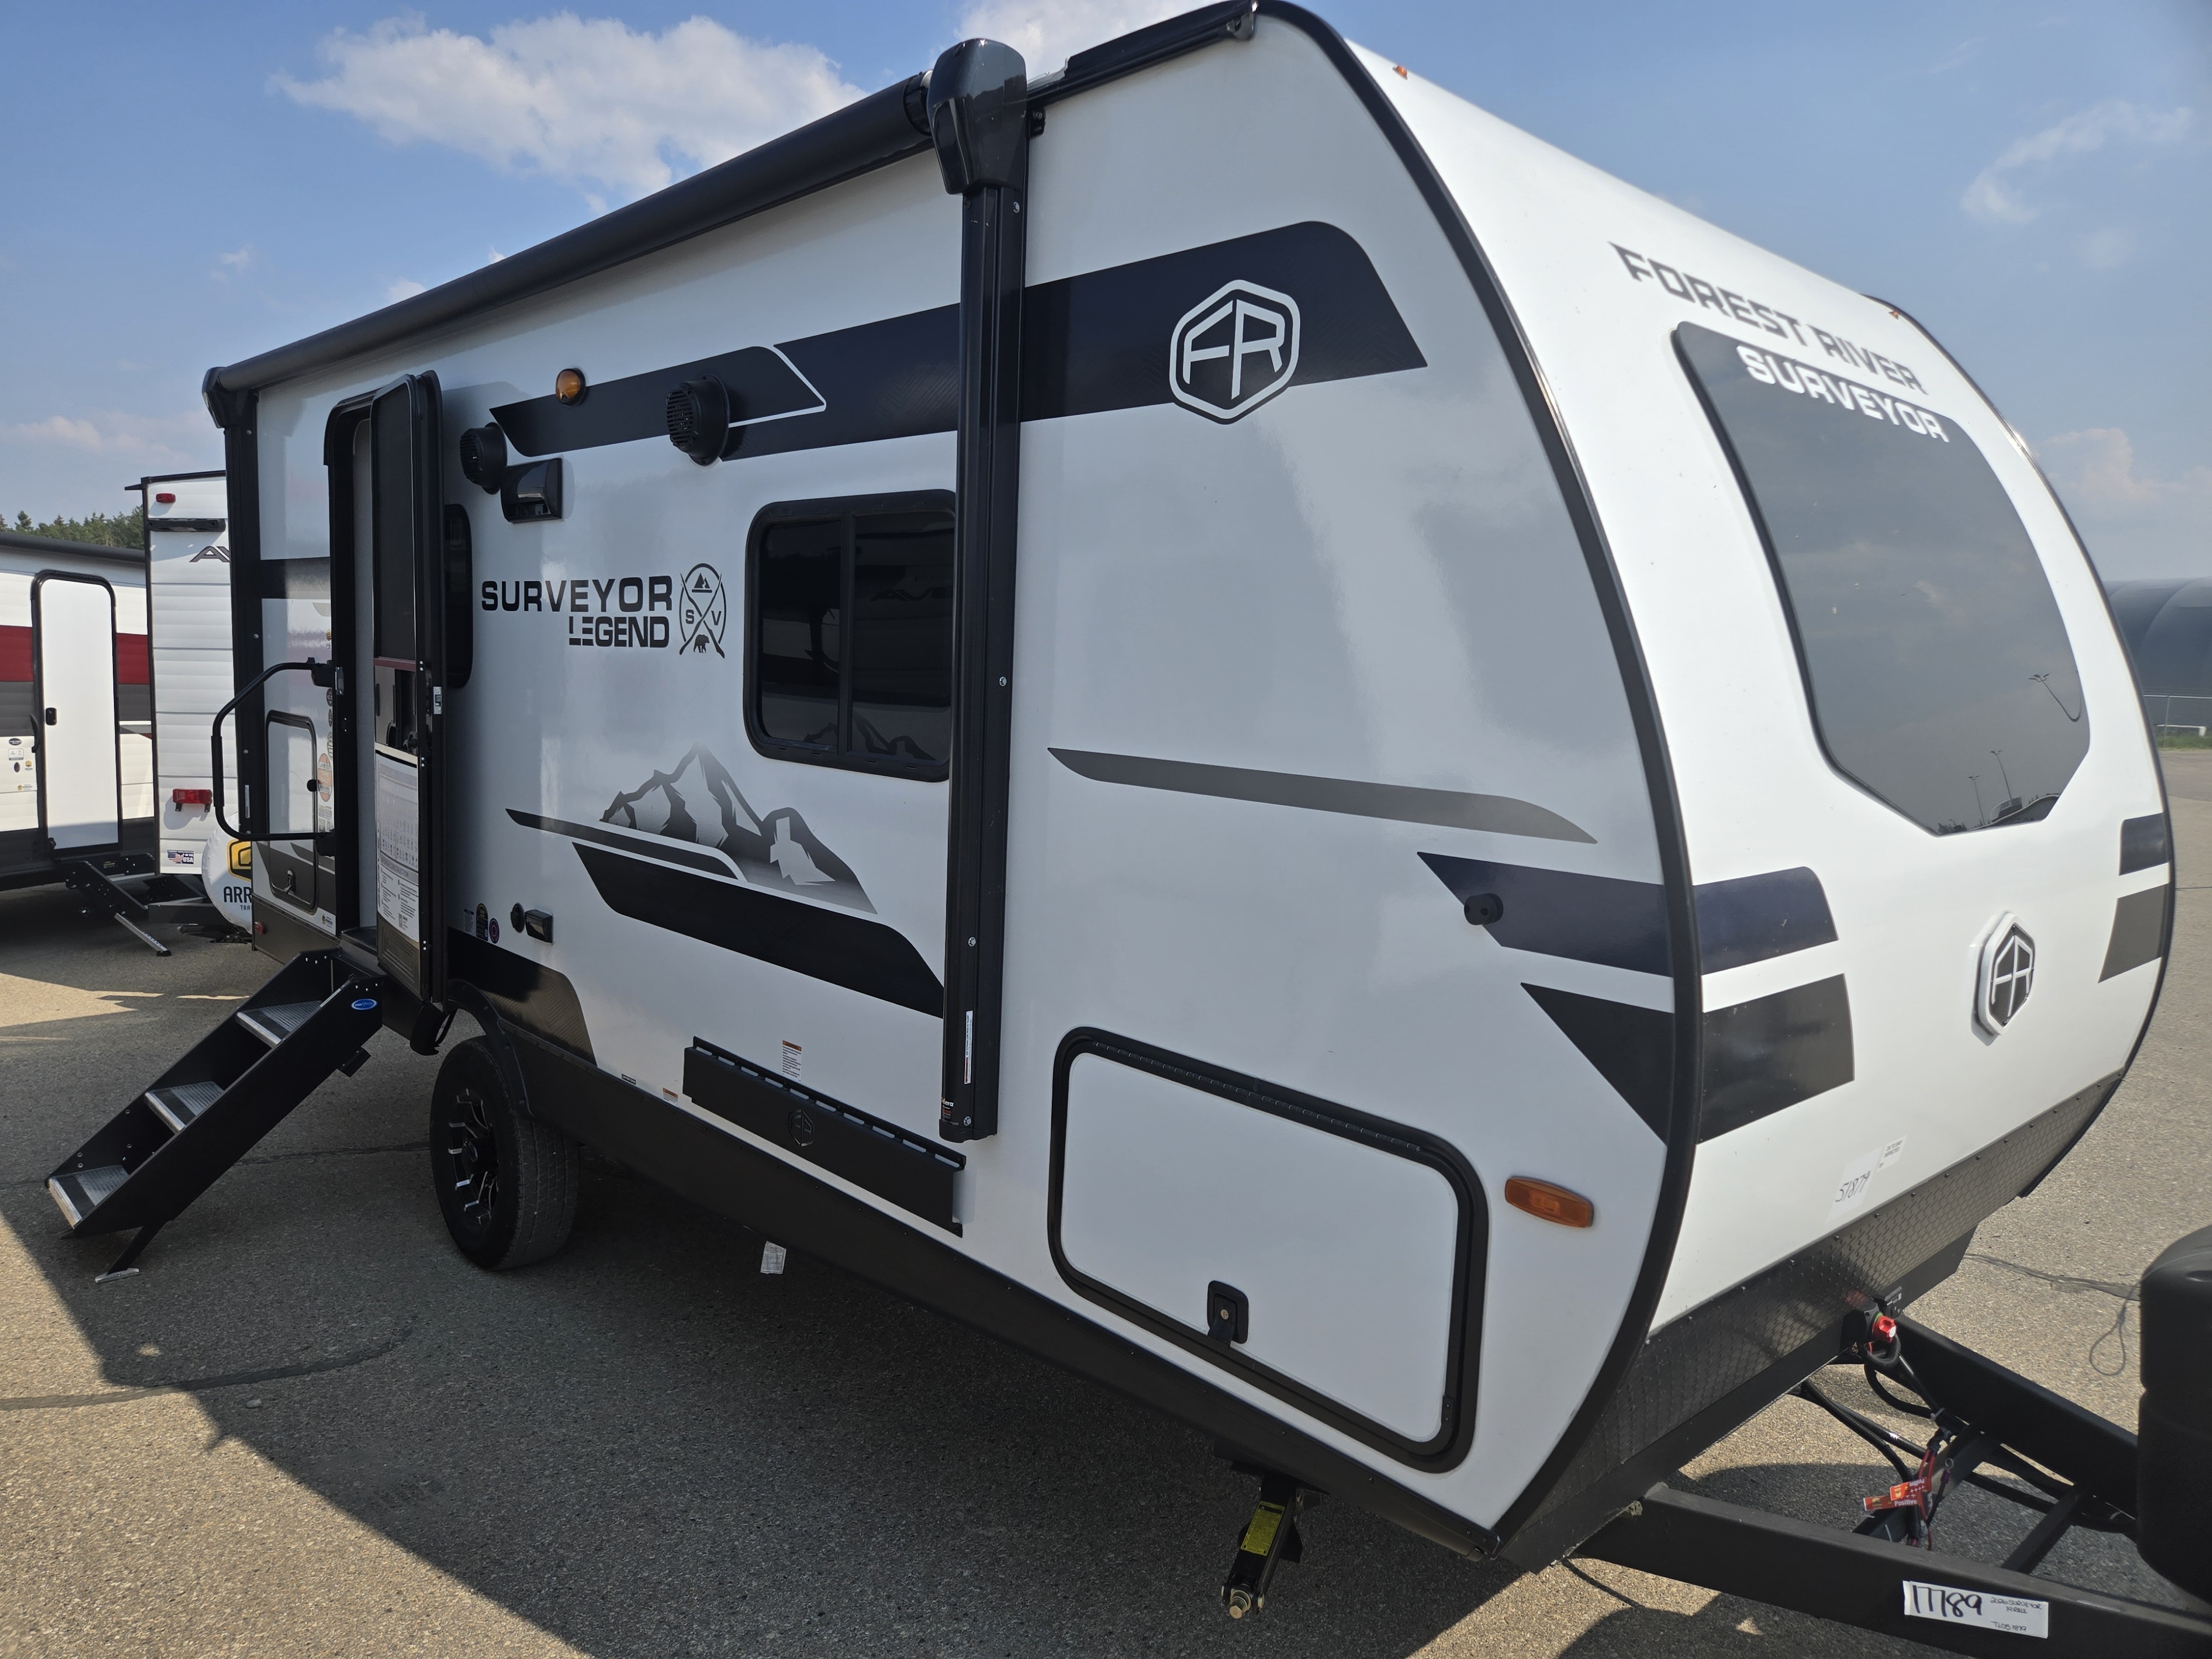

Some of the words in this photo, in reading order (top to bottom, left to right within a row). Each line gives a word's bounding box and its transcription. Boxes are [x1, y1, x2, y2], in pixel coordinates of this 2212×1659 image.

[1607, 241, 1807, 347] FOREST
[1809, 324, 1929, 396] RIVER
[1735, 345, 1950, 443] SURVEYOR
[481, 575, 673, 613] SURVEYOR
[568, 614, 670, 649] LEGEND
[2008, 1599, 2043, 1610] SURVEYOR
